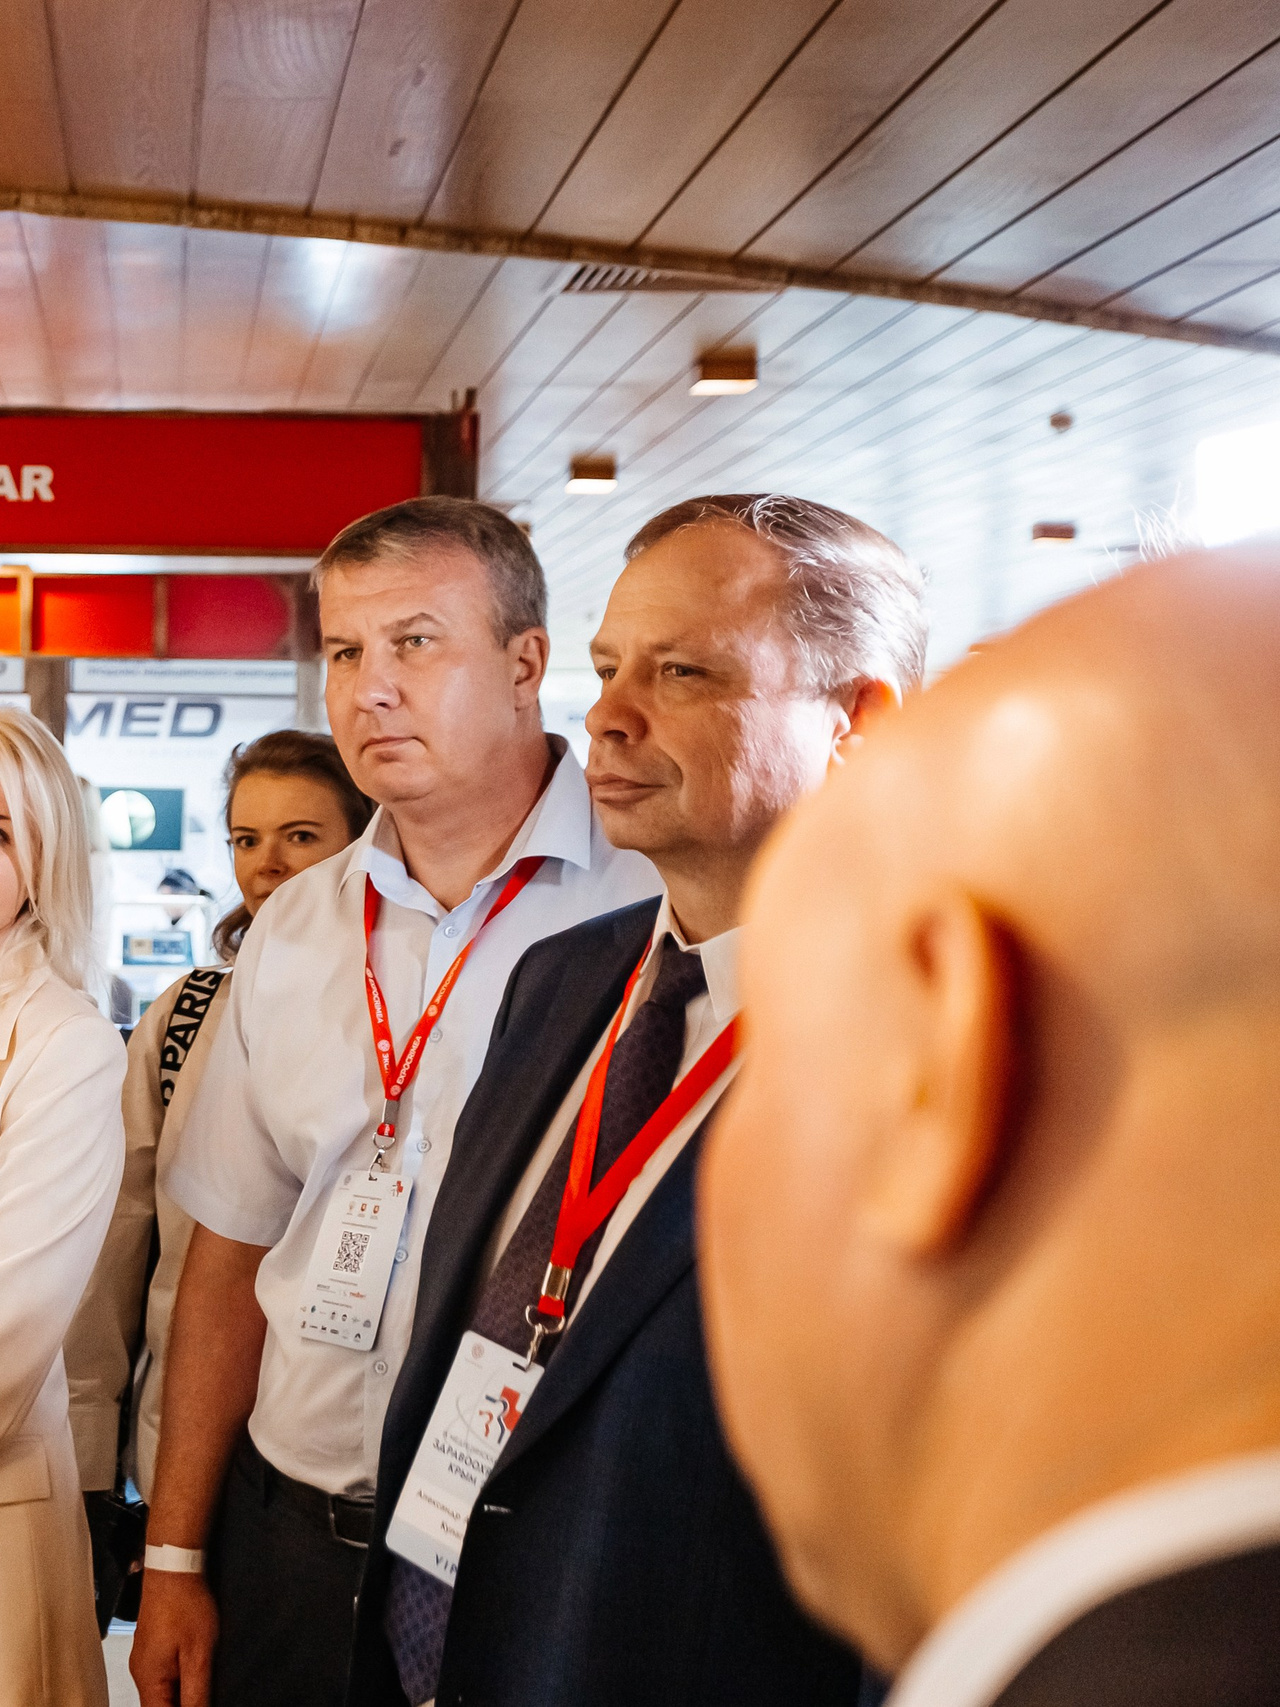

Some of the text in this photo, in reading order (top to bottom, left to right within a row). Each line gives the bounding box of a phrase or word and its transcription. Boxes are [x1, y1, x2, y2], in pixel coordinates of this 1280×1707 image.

[67, 701, 224, 738] MED
[160, 969, 224, 1073] PARIS
[396, 1035, 423, 1086] EXPOCRIMEA
